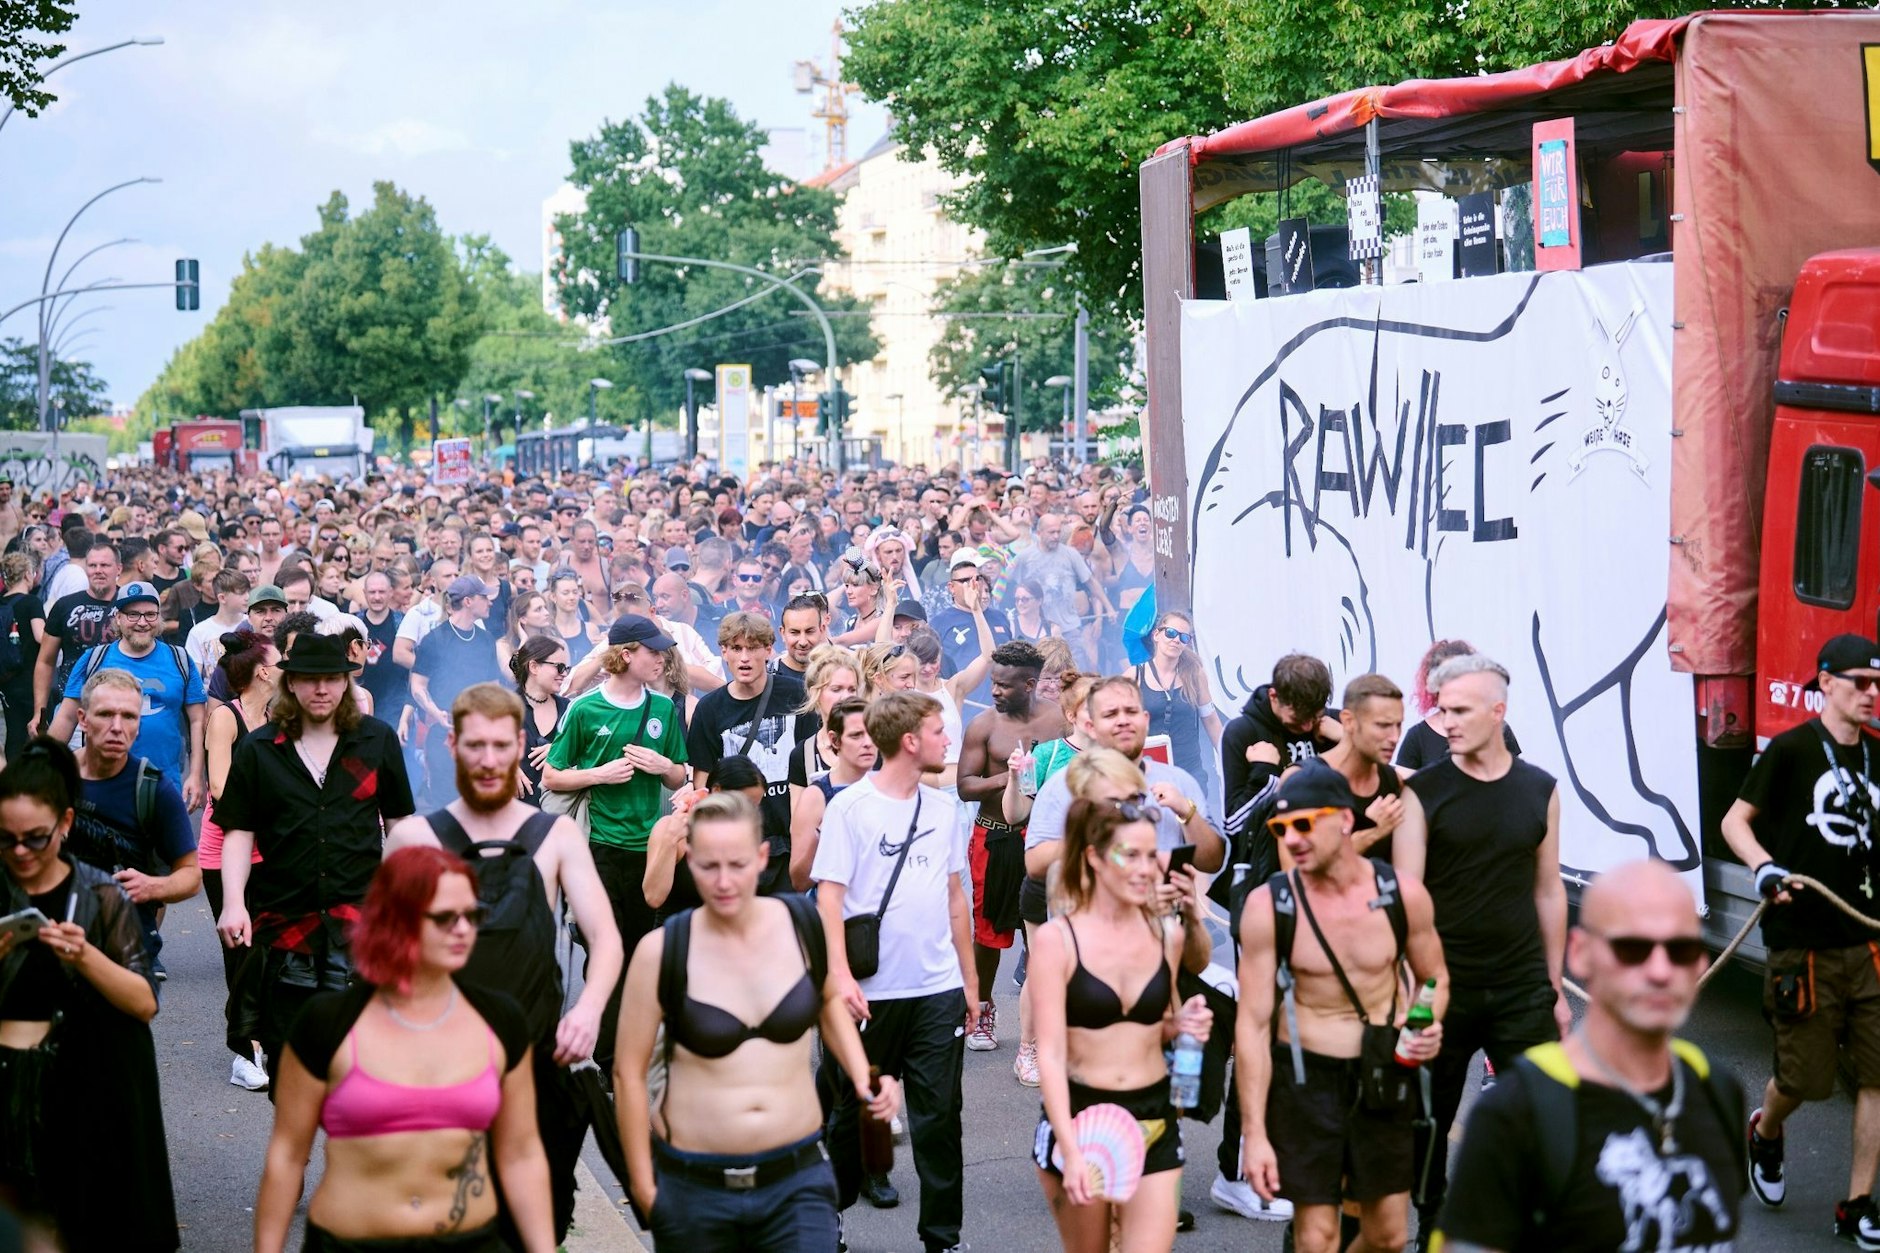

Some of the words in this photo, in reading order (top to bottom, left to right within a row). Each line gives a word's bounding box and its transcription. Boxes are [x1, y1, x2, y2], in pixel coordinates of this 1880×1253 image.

[1541, 150, 1565, 177] WIR
[1543, 206, 1569, 233] EUCH
[908, 855, 929, 869] IR
